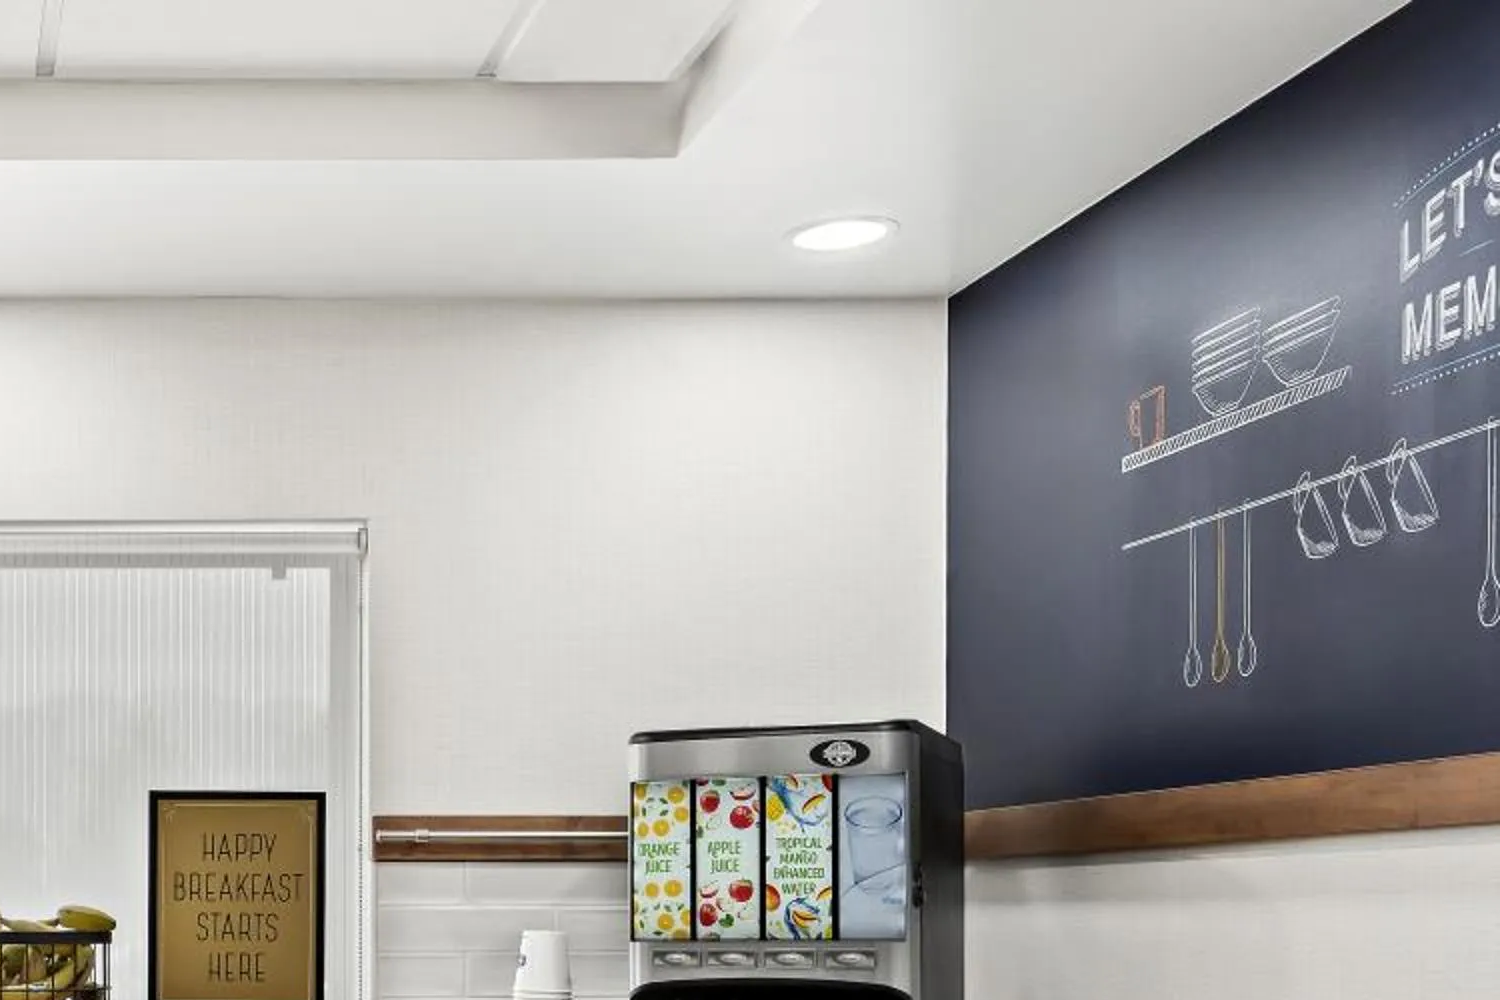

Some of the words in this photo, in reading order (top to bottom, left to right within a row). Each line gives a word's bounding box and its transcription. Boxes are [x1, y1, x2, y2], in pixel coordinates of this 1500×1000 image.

[202, 832, 278, 863] HAPPY
[707, 840, 742, 857] APPLE
[775, 836, 822, 851] TROPICAL
[779, 850, 817, 864] MANGO
[645, 859, 673, 875] JUICE
[710, 859, 741, 874] JUICE
[773, 866, 825, 880] ENHANCED
[172, 871, 306, 903] BREAKFAST
[781, 882, 817, 896] WATER
[196, 911, 280, 943] STARTS
[207, 951, 267, 983] HERE
